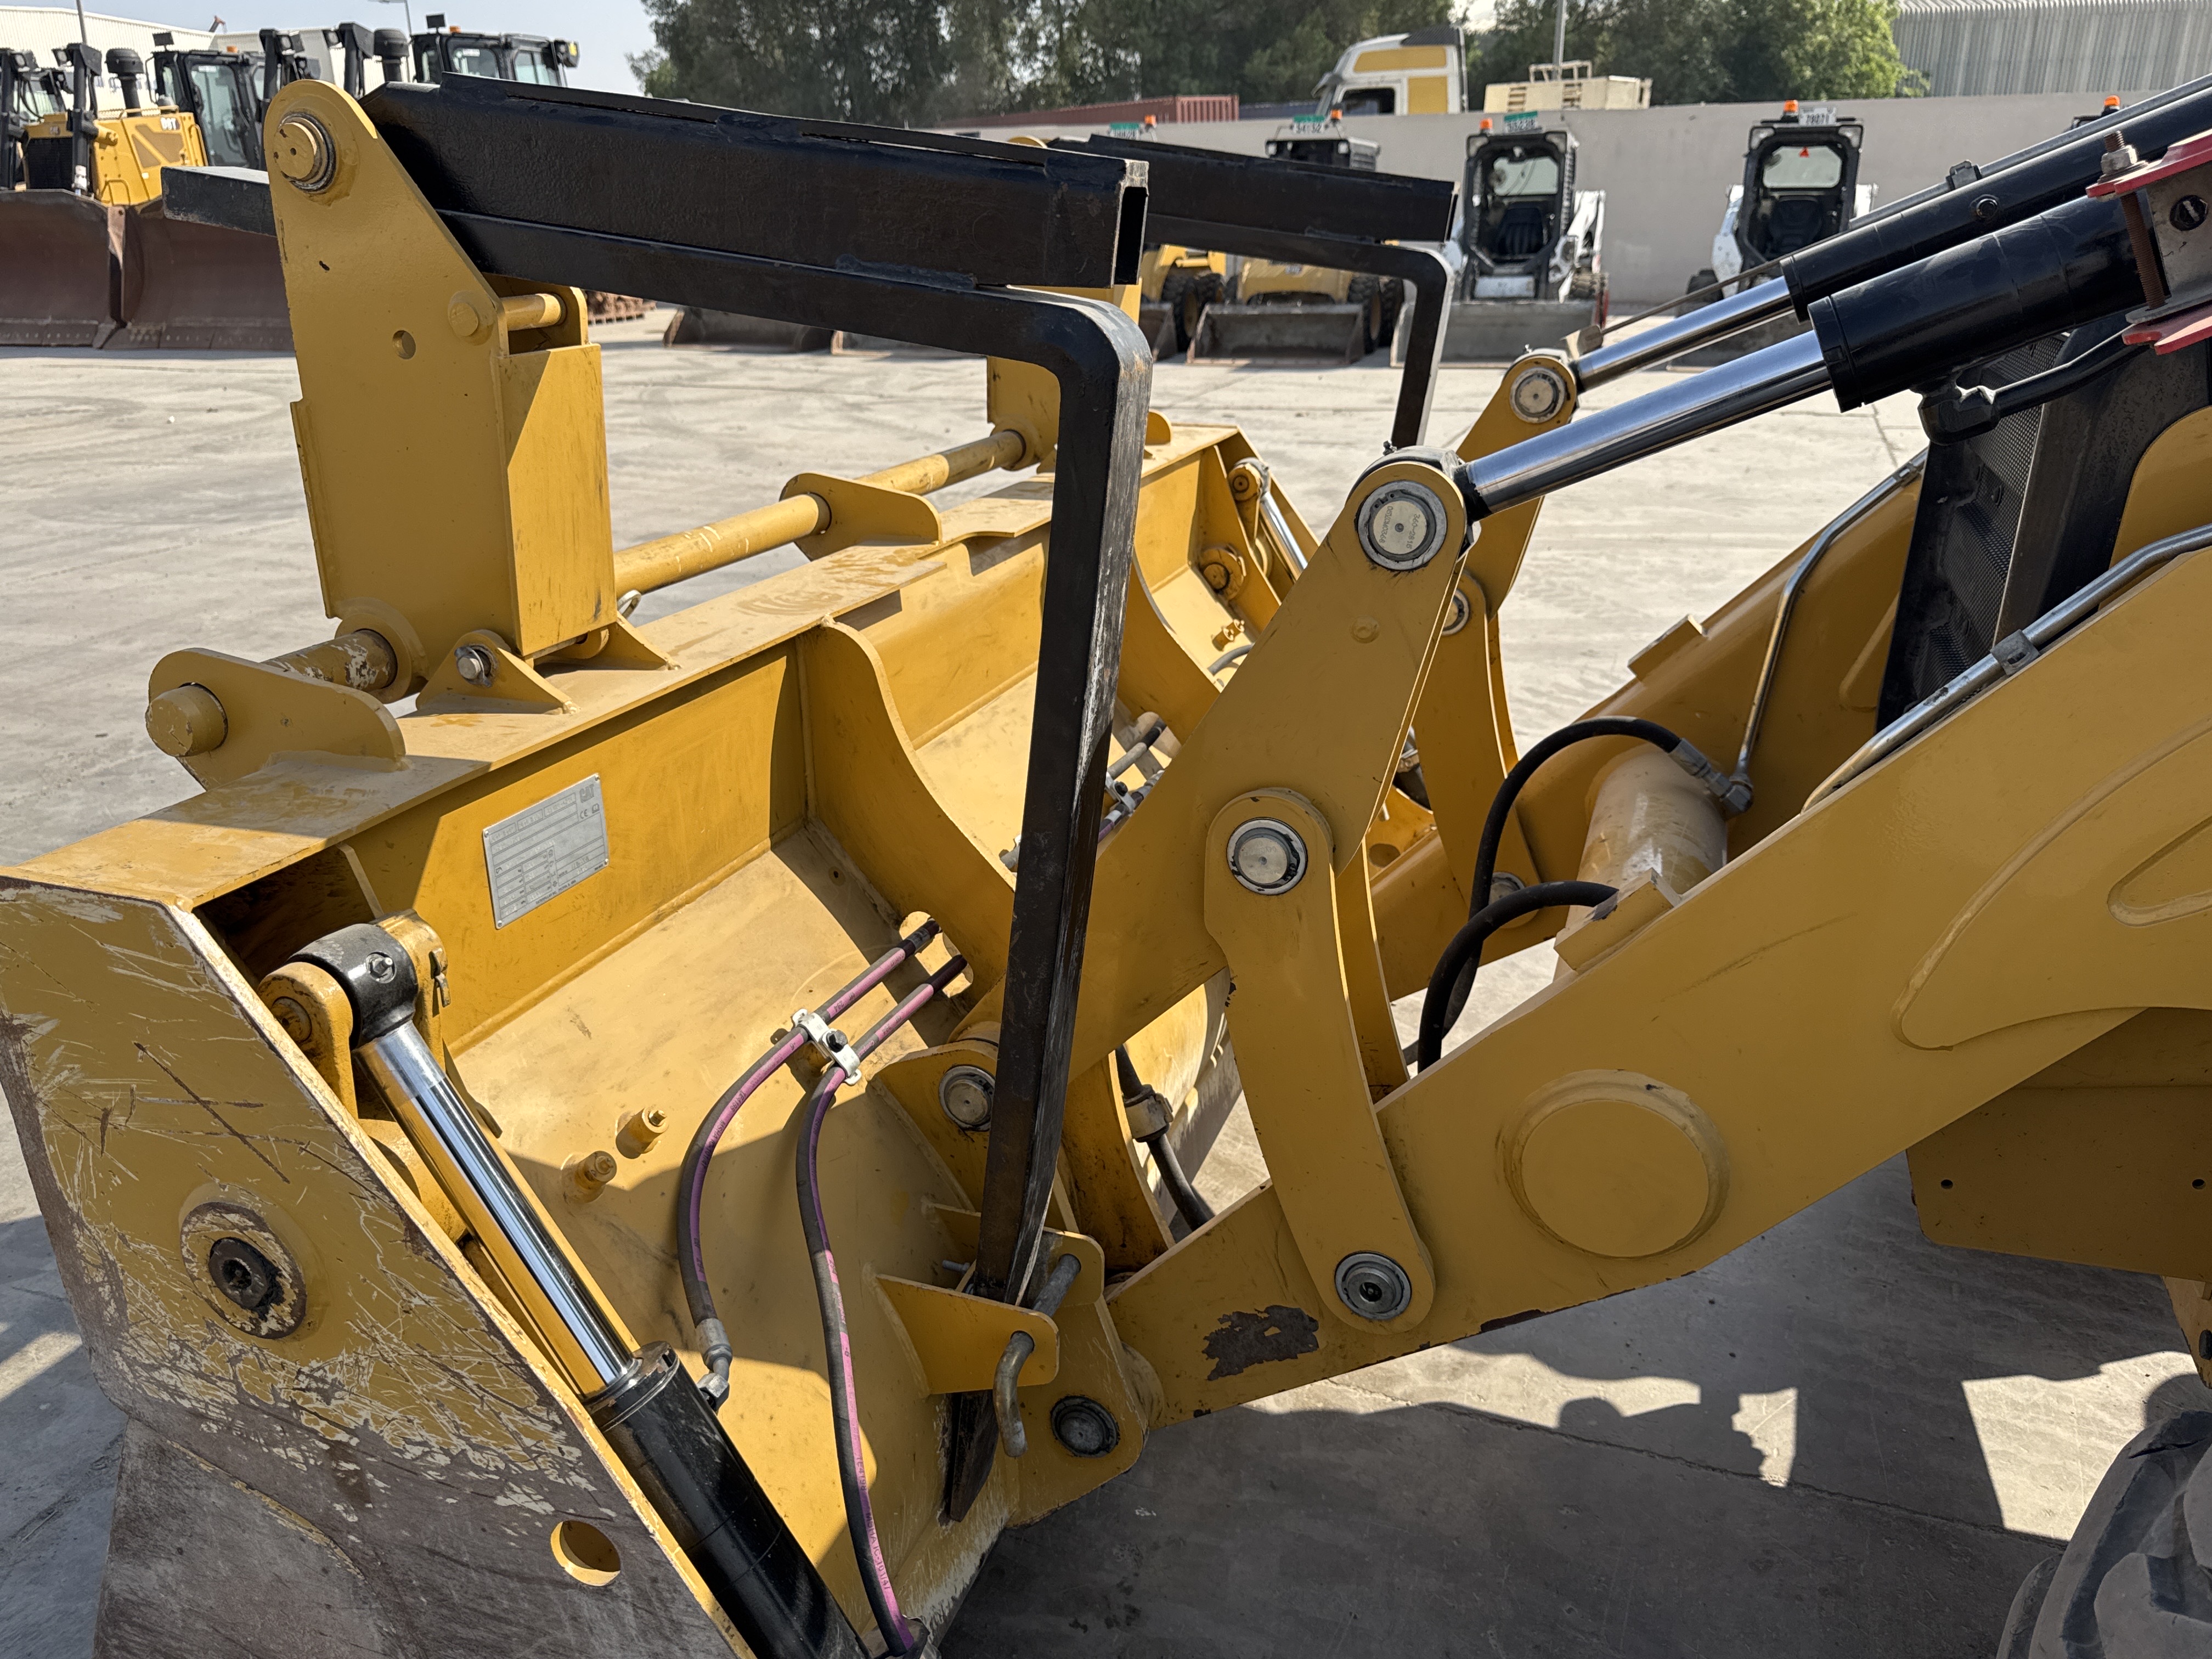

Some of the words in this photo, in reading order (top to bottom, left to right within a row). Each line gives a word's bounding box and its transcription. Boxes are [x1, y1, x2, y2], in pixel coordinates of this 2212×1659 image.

[1406, 514, 1420, 549] 360-2815
[579, 783, 594, 803] CAT
[580, 809, 588, 819] CE
[714, 1120, 726, 1140] MSHA
[856, 1456, 867, 1491] 1E4198
[866, 1513, 877, 1544] MSHA
